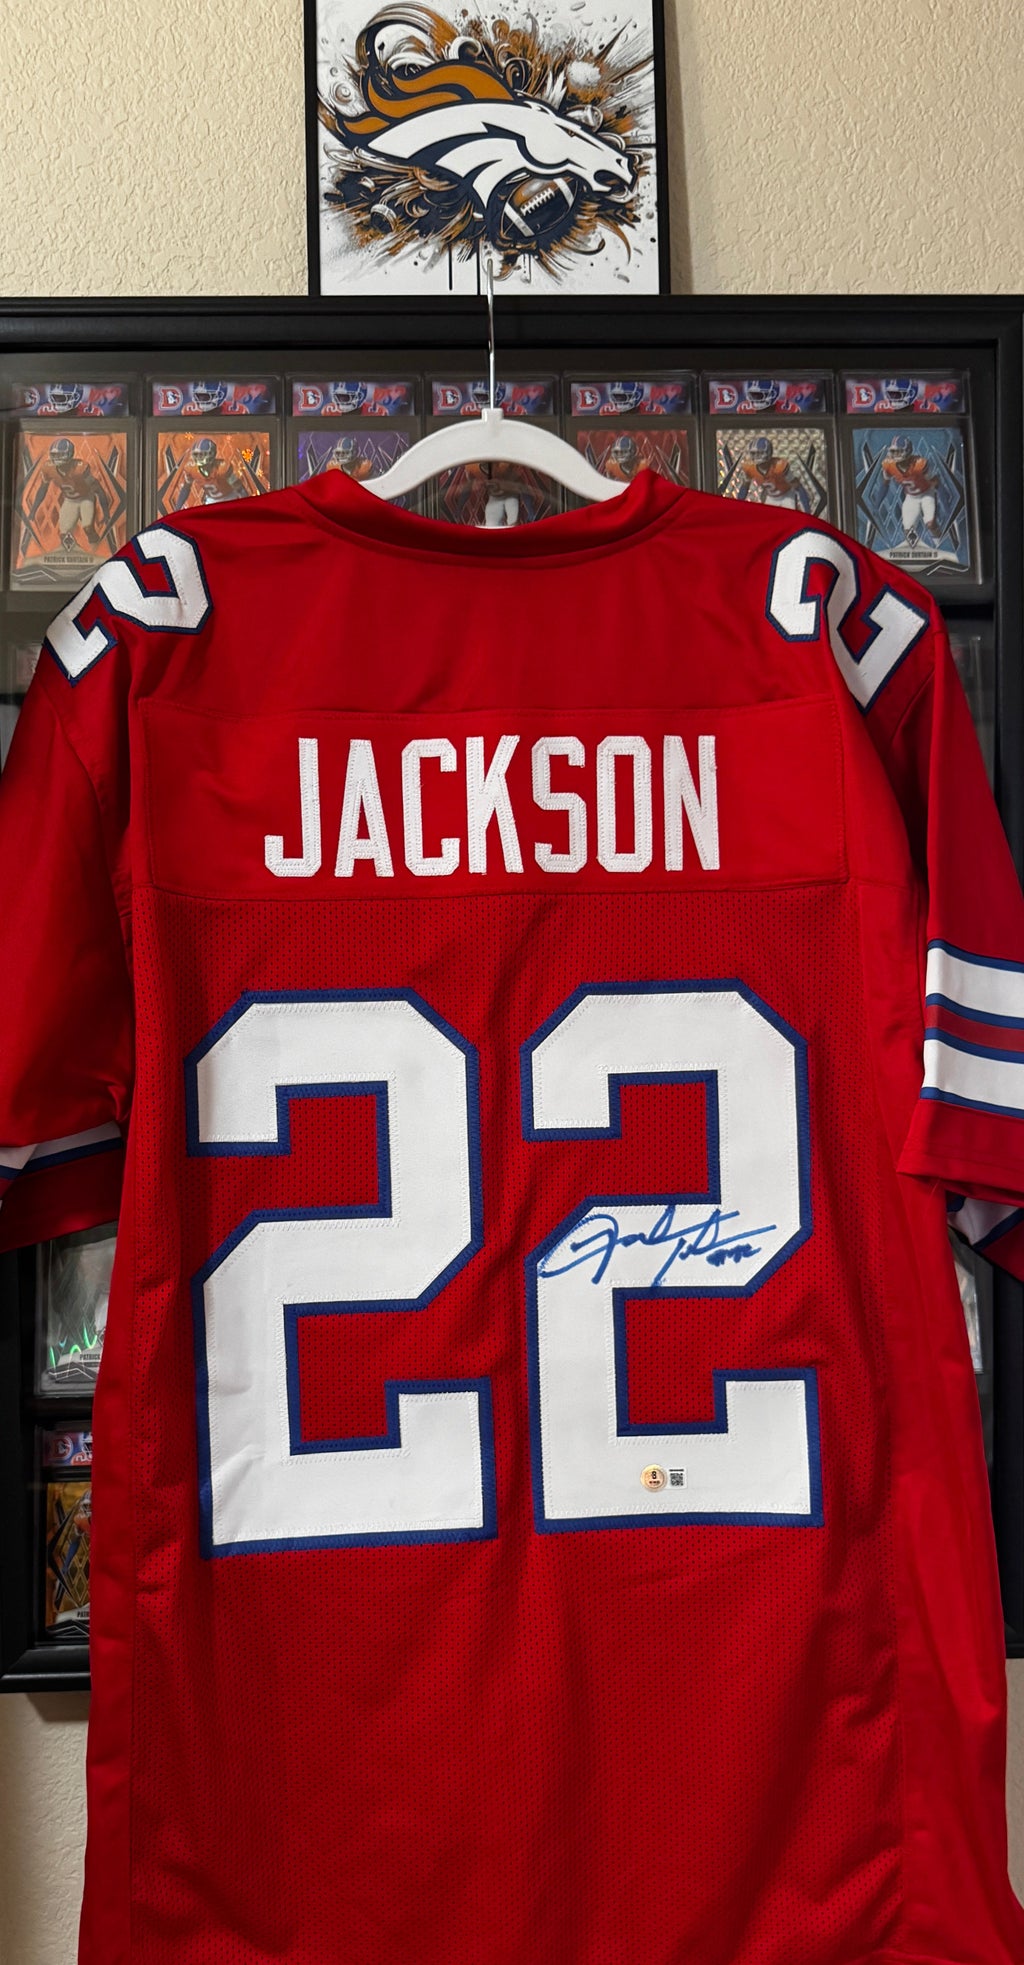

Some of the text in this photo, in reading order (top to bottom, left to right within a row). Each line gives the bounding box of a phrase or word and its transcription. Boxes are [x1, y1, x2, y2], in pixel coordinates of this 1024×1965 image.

[42, 522, 213, 688] 2
[765, 527, 930, 716] 2
[264, 735, 720, 877] JACKSON
[184, 978, 824, 1559] 22
